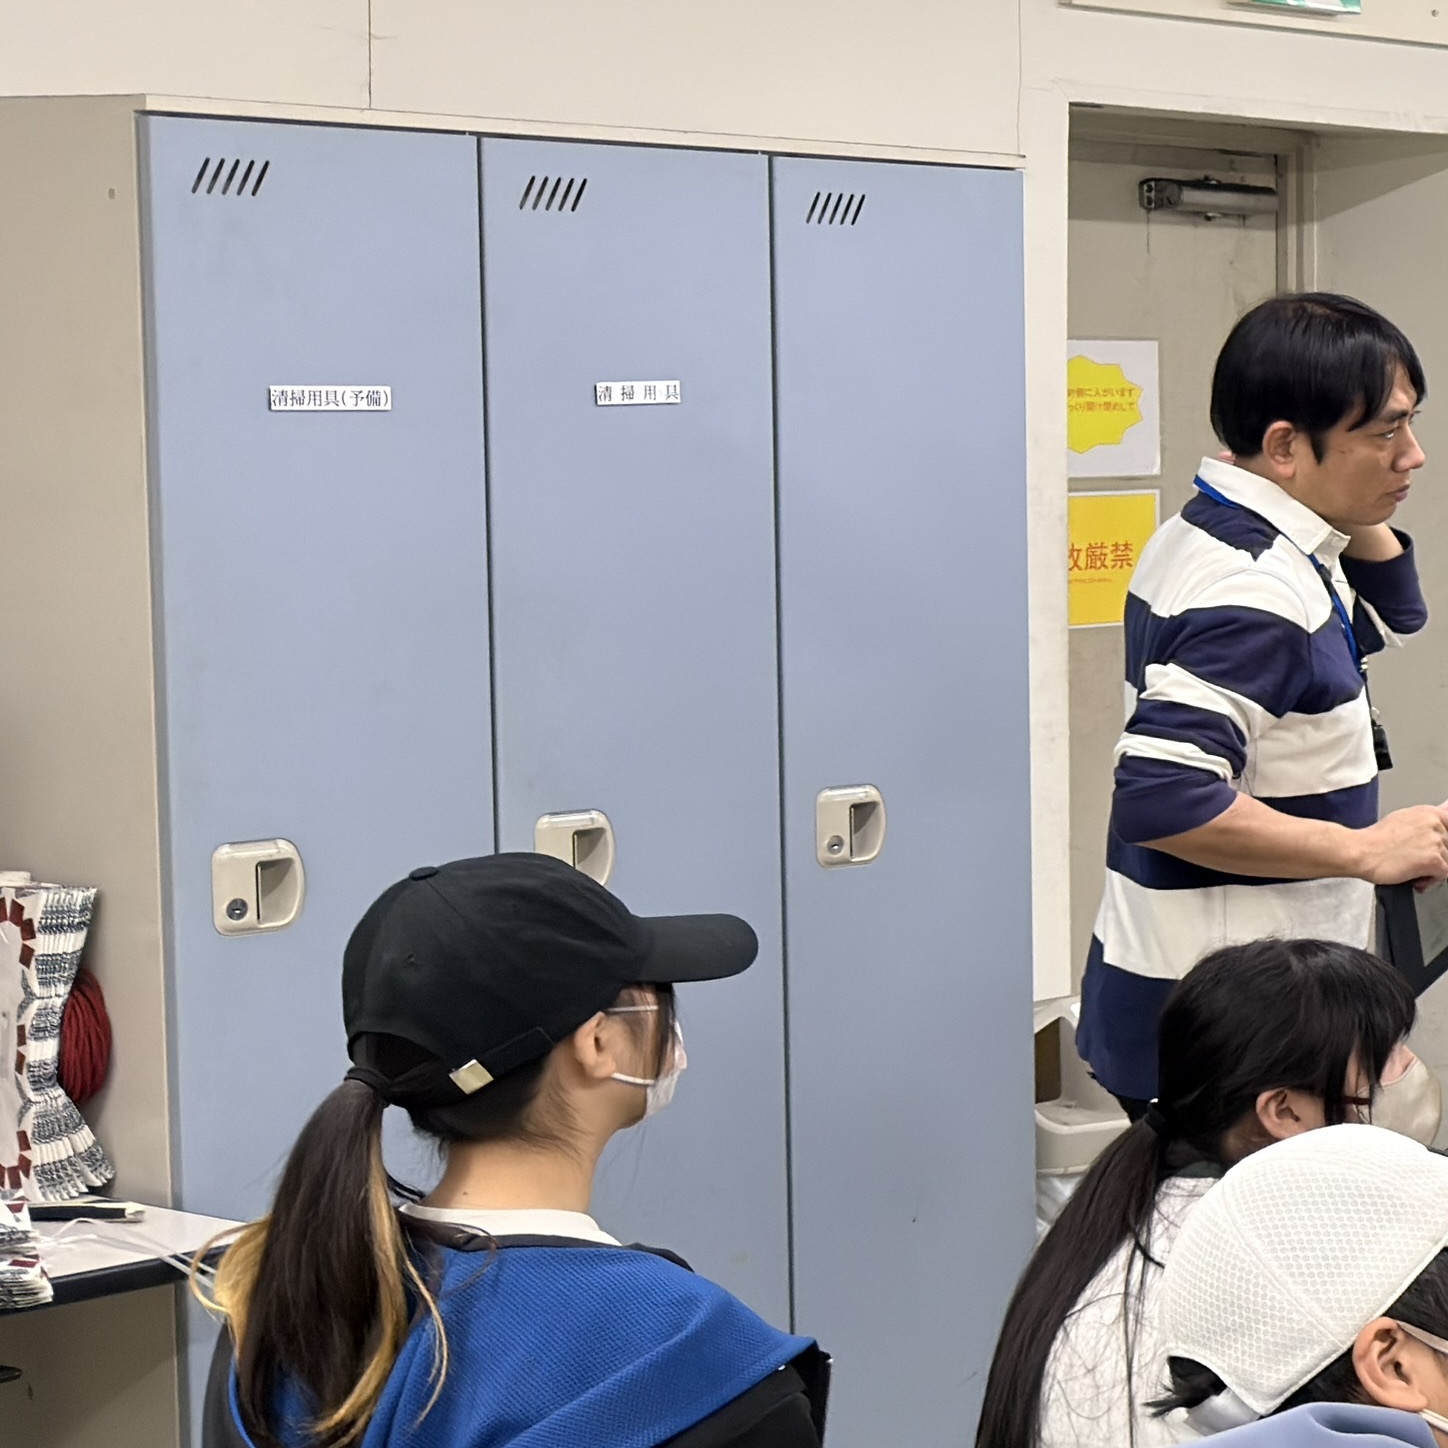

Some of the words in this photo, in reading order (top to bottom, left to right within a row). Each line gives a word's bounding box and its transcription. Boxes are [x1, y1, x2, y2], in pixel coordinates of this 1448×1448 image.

[271, 388, 390, 409] 清掃用具(予備)
[598, 383, 680, 403] 清掃用具
